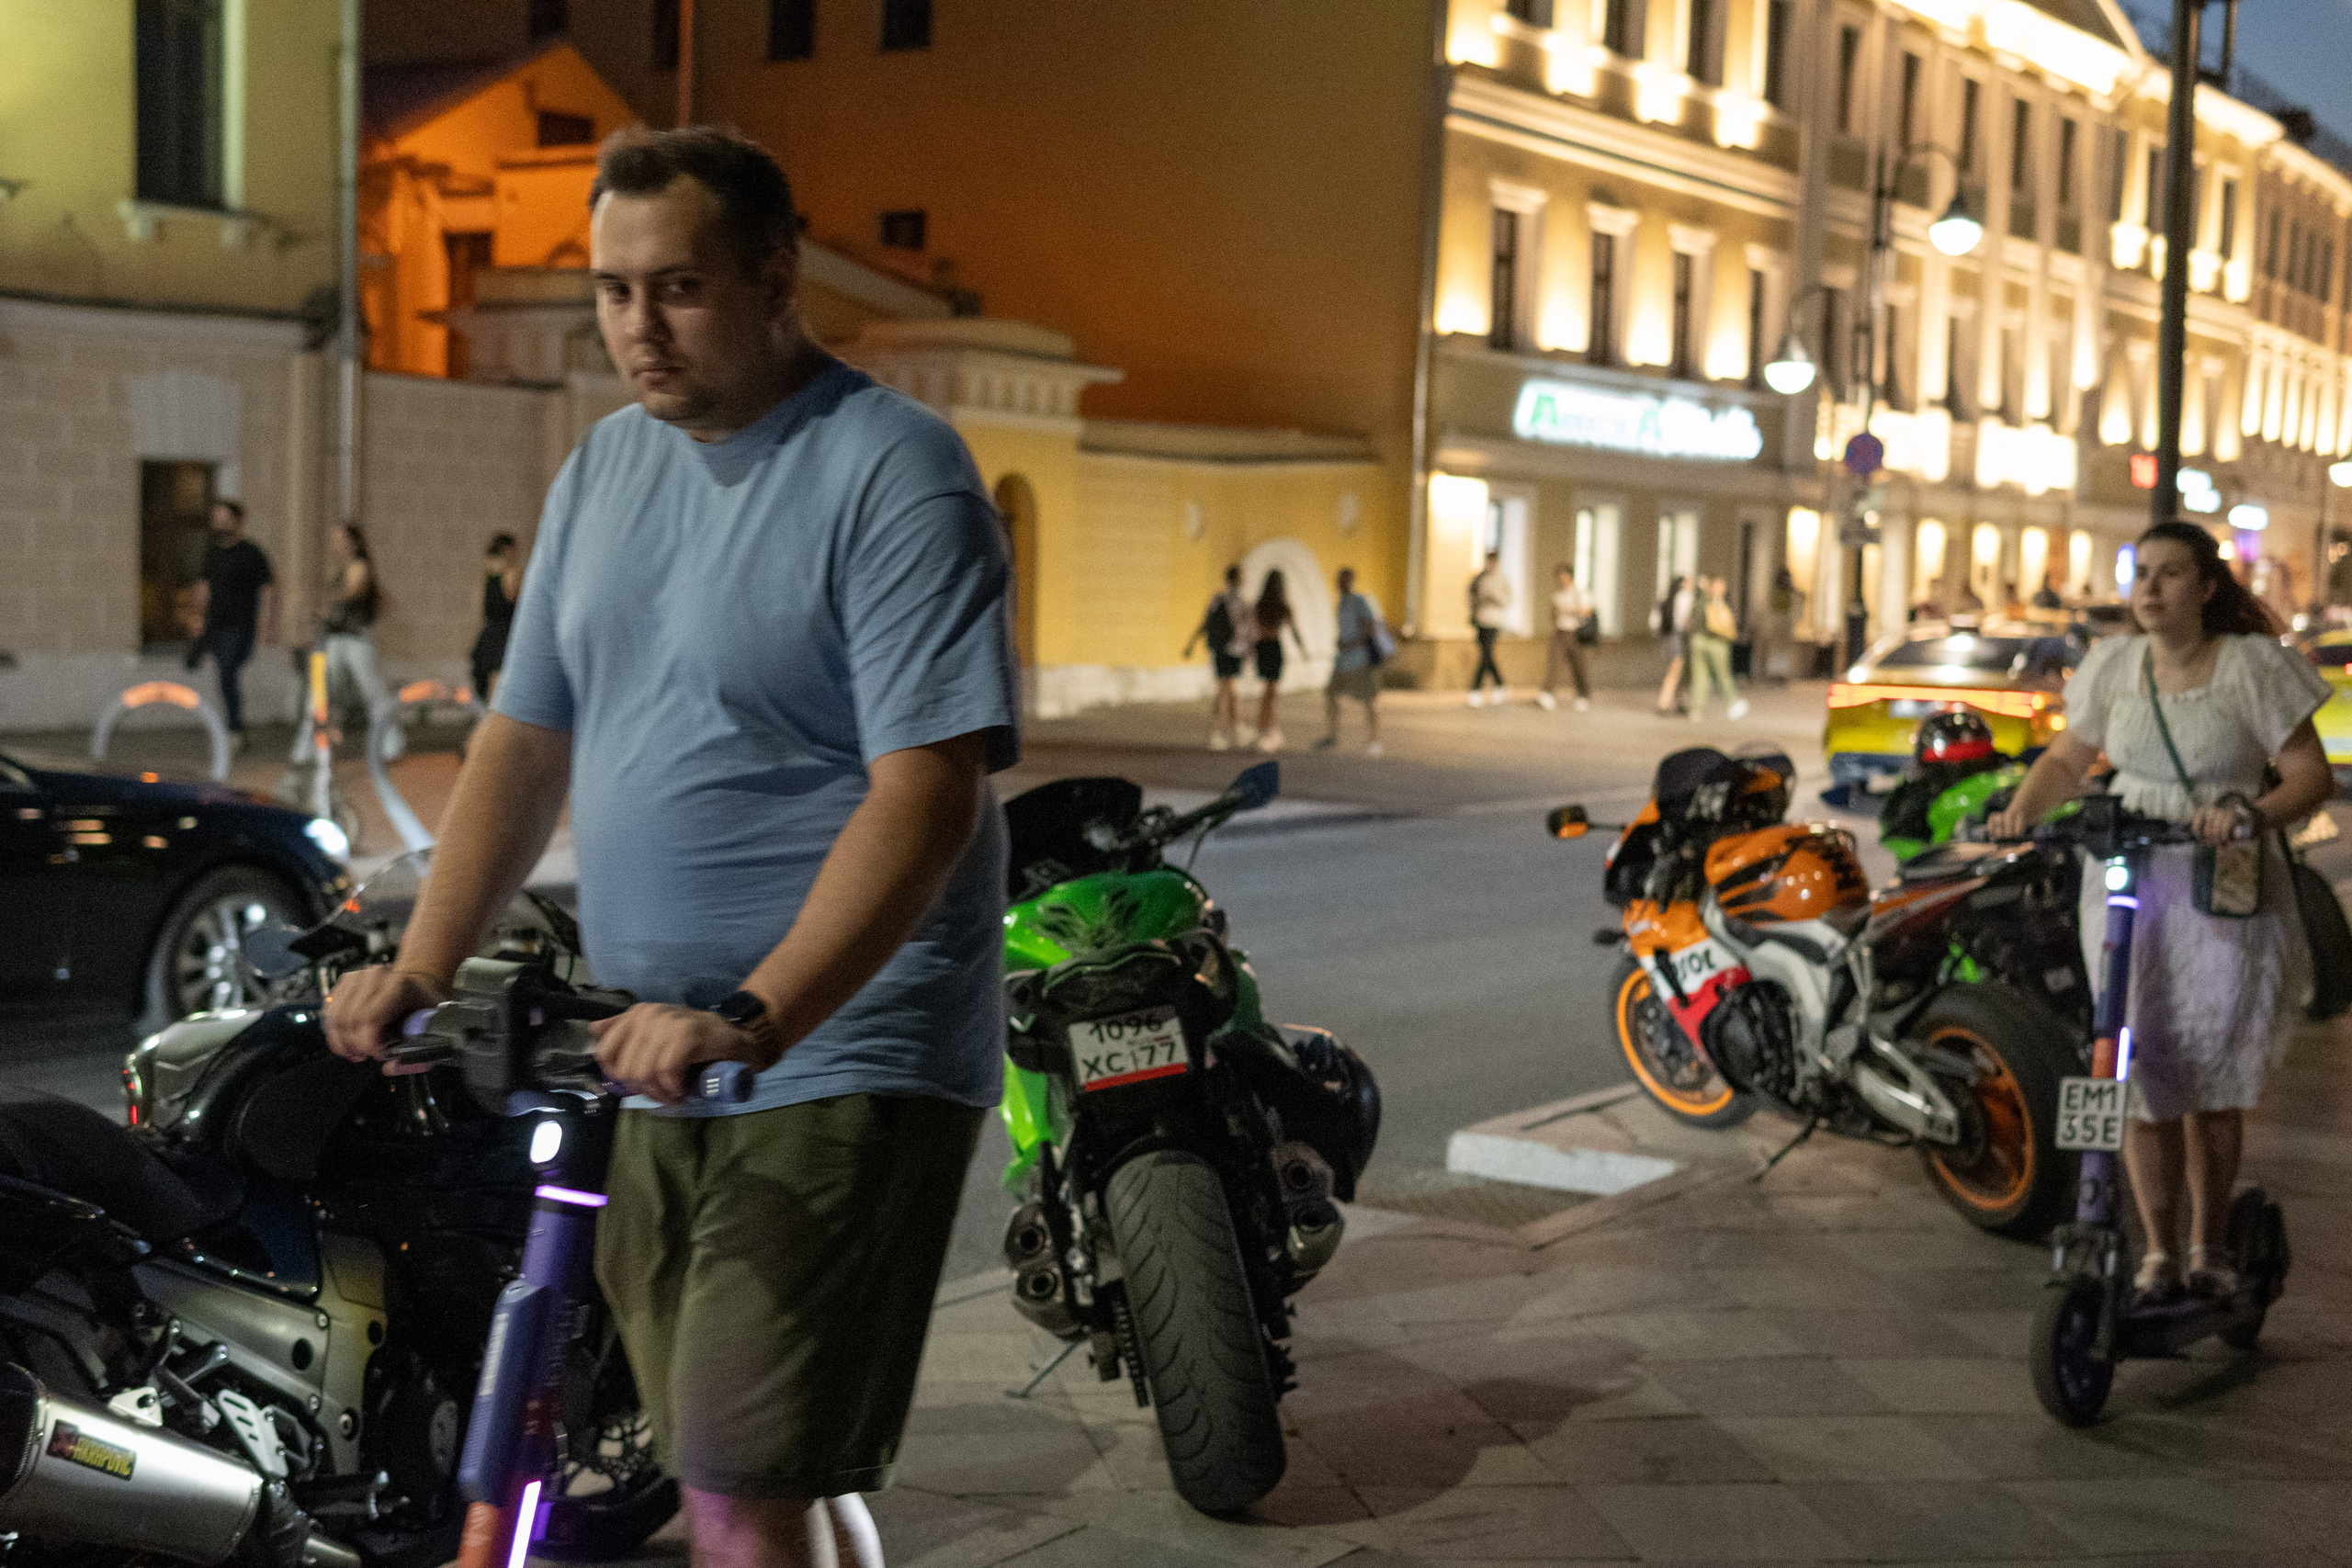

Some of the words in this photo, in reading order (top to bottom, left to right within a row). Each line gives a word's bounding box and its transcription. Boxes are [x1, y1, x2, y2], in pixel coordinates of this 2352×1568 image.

[1089, 1013, 1162, 1043] 1096
[1081, 1053, 1126, 1078] XC
[1139, 1041, 1176, 1066] 77
